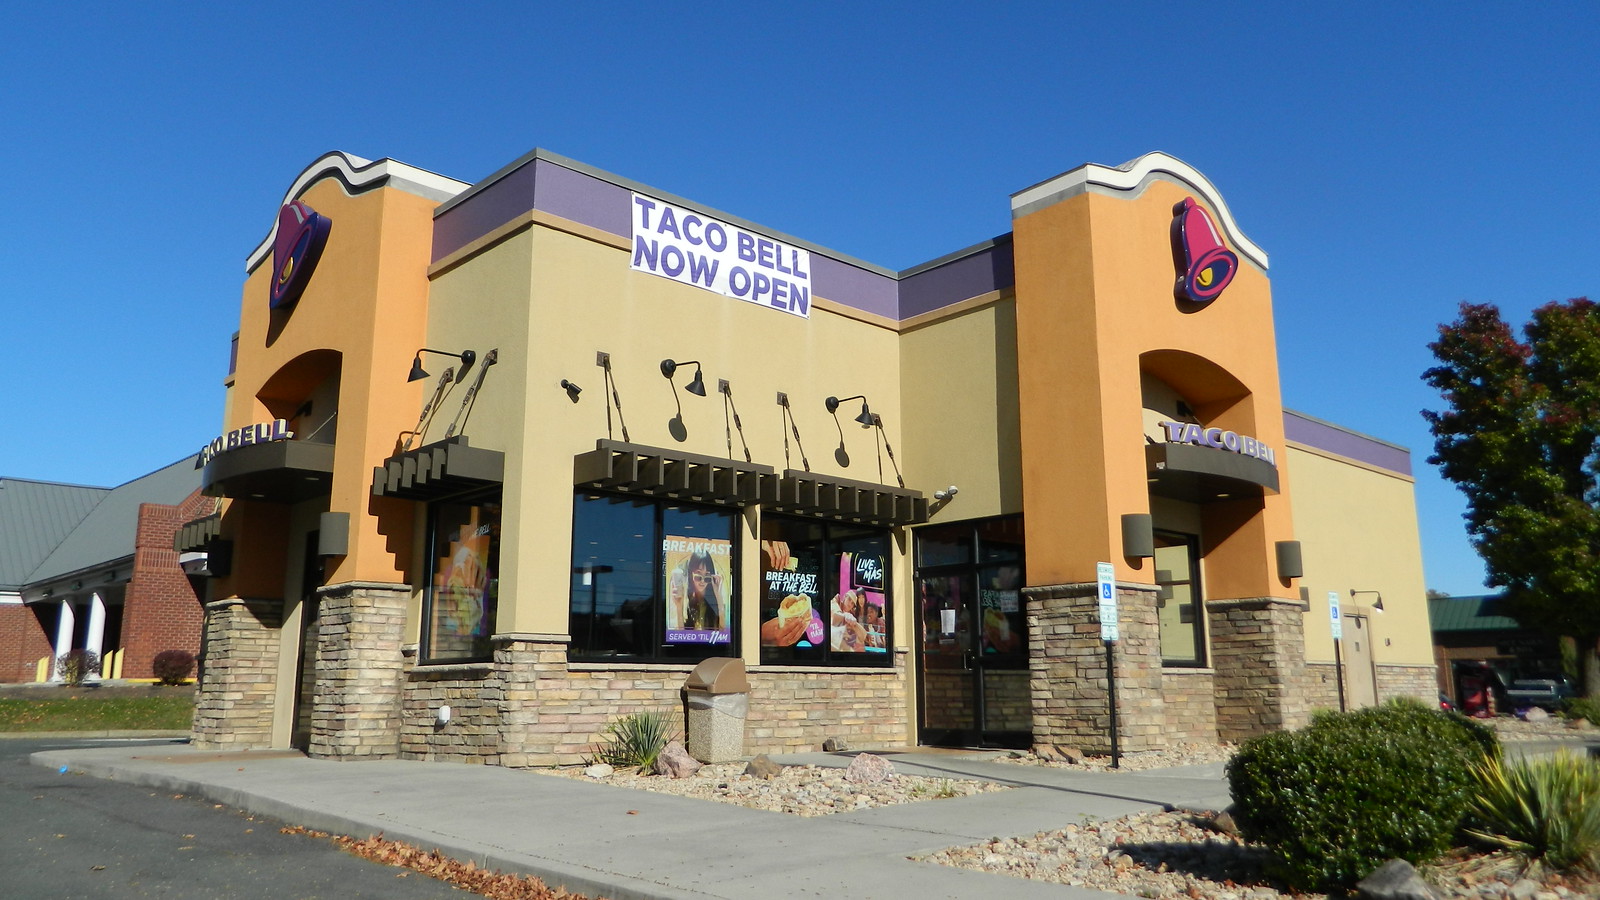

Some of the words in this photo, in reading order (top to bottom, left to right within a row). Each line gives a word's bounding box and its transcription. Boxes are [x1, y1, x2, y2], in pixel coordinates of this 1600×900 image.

[635, 196, 728, 253] TACO
[737, 231, 808, 280] BELL
[633, 235, 720, 288] NOW
[729, 266, 808, 315] OPEN
[226, 418, 294, 451] BELL
[1158, 420, 1241, 453] TACO
[662, 539, 732, 556] BREAKFAST
[856, 558, 876, 572] LIVE
[766, 571, 816, 584] BREAKFAST
[769, 581, 782, 590] AT
[782, 581, 799, 593] THE
[669, 633, 697, 641] SERVED
